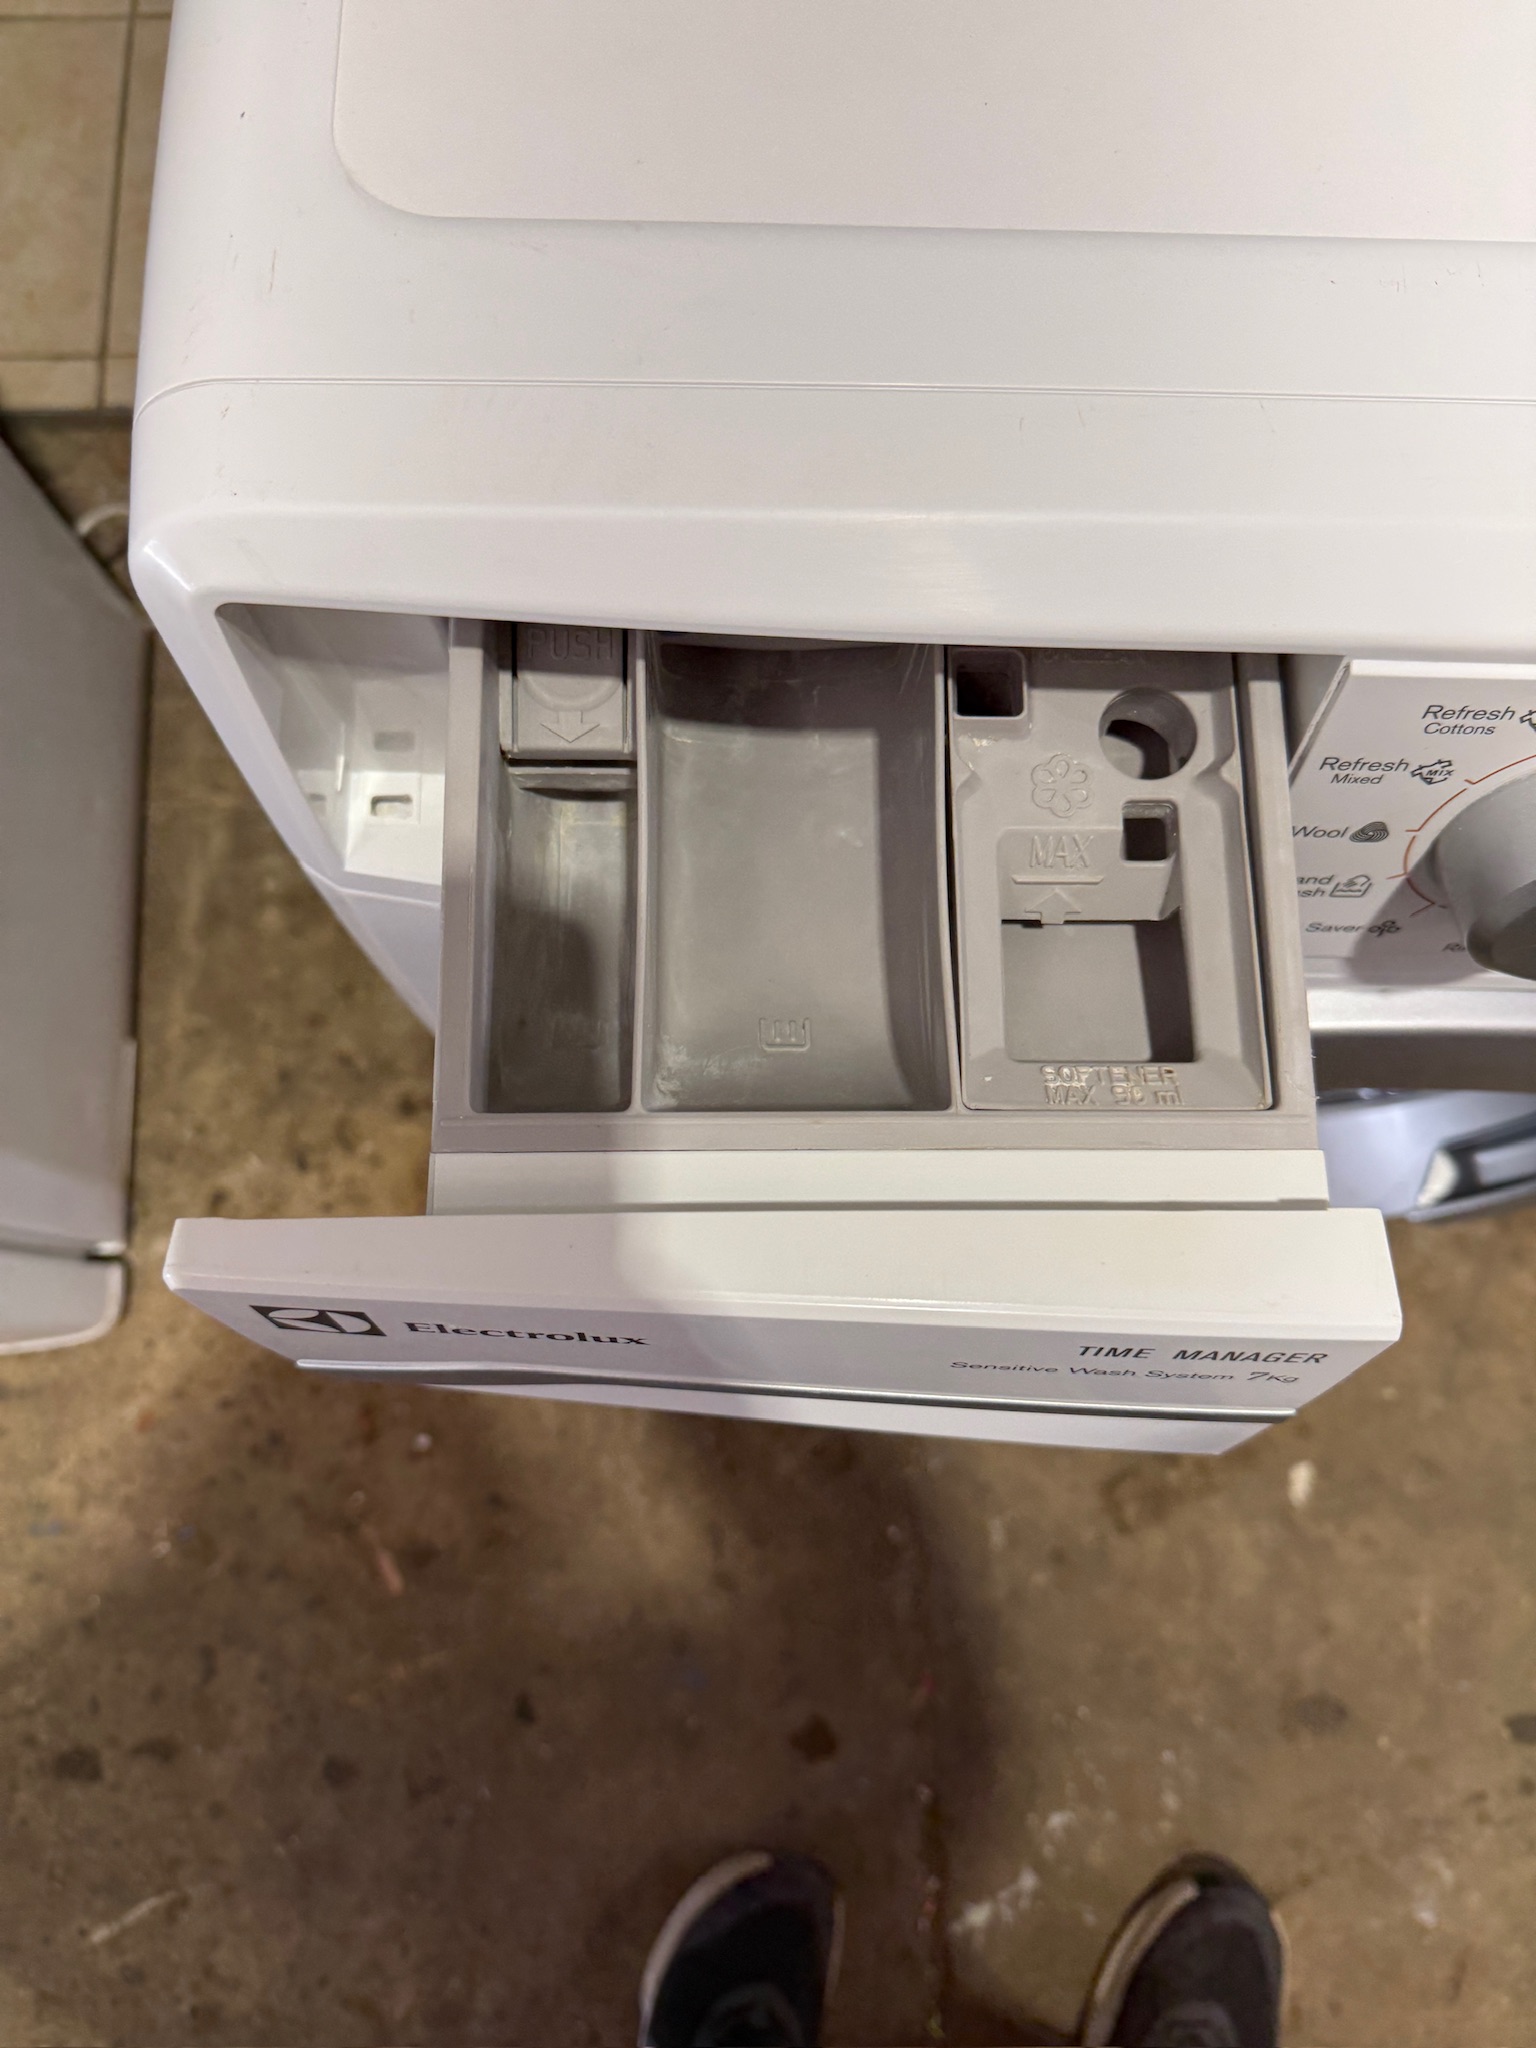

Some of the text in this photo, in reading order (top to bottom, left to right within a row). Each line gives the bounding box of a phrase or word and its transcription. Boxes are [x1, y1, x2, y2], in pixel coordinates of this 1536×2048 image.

[527, 627, 614, 660] PUSH
[1421, 704, 1516, 721] Refresh
[1423, 722, 1496, 736] Cottons
[1319, 757, 1410, 772] Refresh
[1330, 774, 1384, 785] Mixed
[1292, 825, 1349, 838] Wool
[1028, 834, 1095, 868] MAX
[1297, 874, 1335, 885] and
[1305, 922, 1363, 934] Saver
[1041, 1065, 1179, 1085] SOFTENER
[1044, 1084, 1099, 1106] MAX
[403, 1321, 650, 1347] Electrolux
[1078, 1345, 1330, 1365] TIME MANAGER
[950, 1360, 1301, 1385] Sensitive Wash System 7Kg
